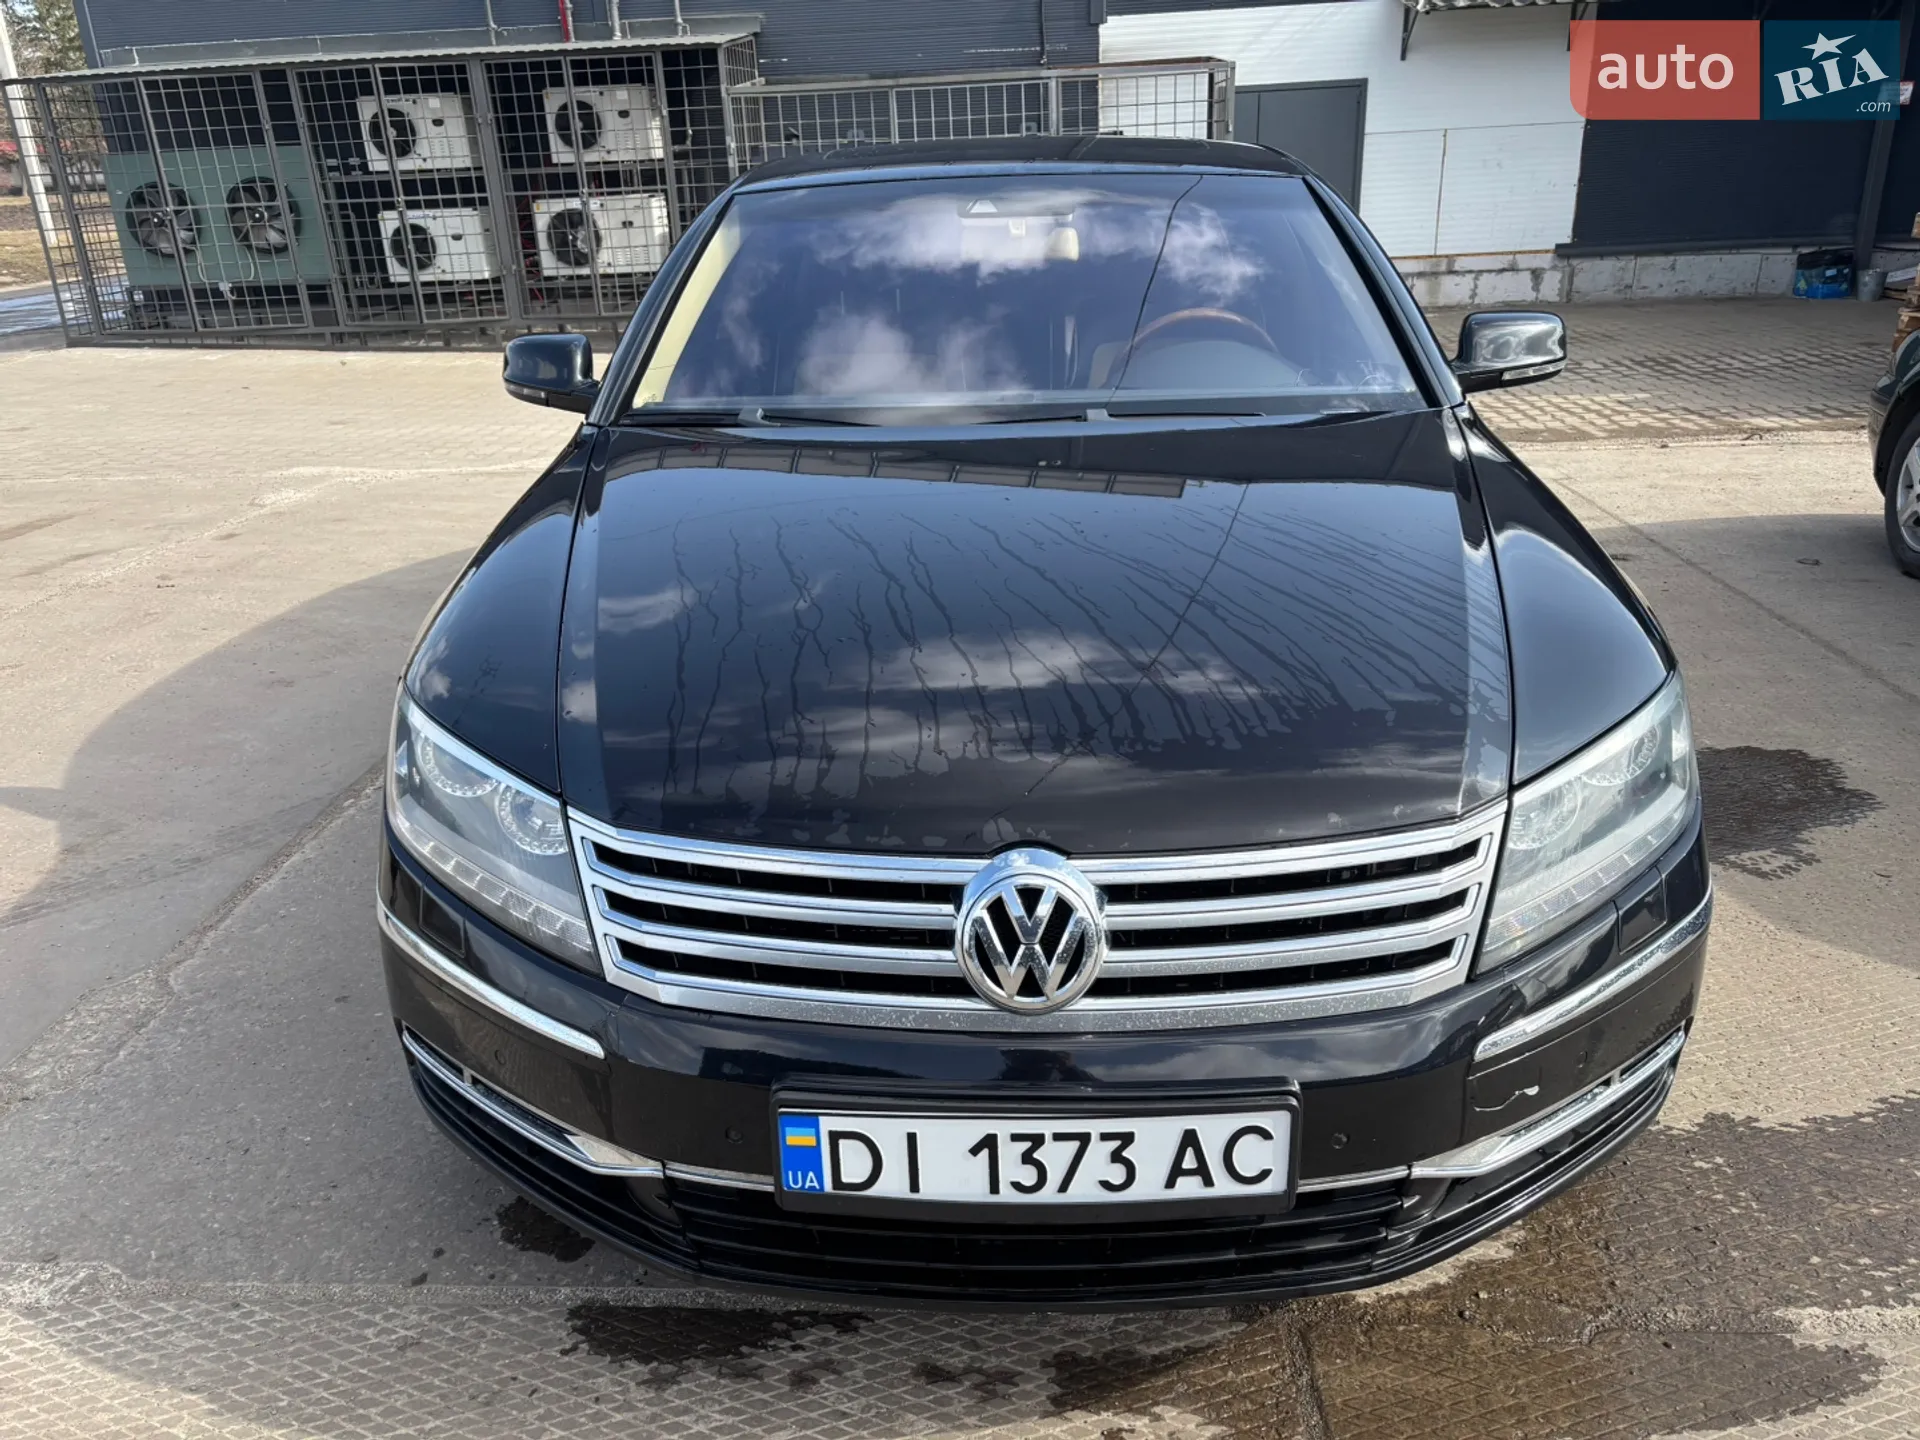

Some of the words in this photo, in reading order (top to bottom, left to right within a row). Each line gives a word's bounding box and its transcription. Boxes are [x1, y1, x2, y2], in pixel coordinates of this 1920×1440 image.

[970, 880, 1088, 1003] VW
[788, 1171, 820, 1190] UA
[829, 1130, 921, 1194] DI
[968, 1132, 1137, 1195] 1373
[1164, 1125, 1274, 1189] AC
